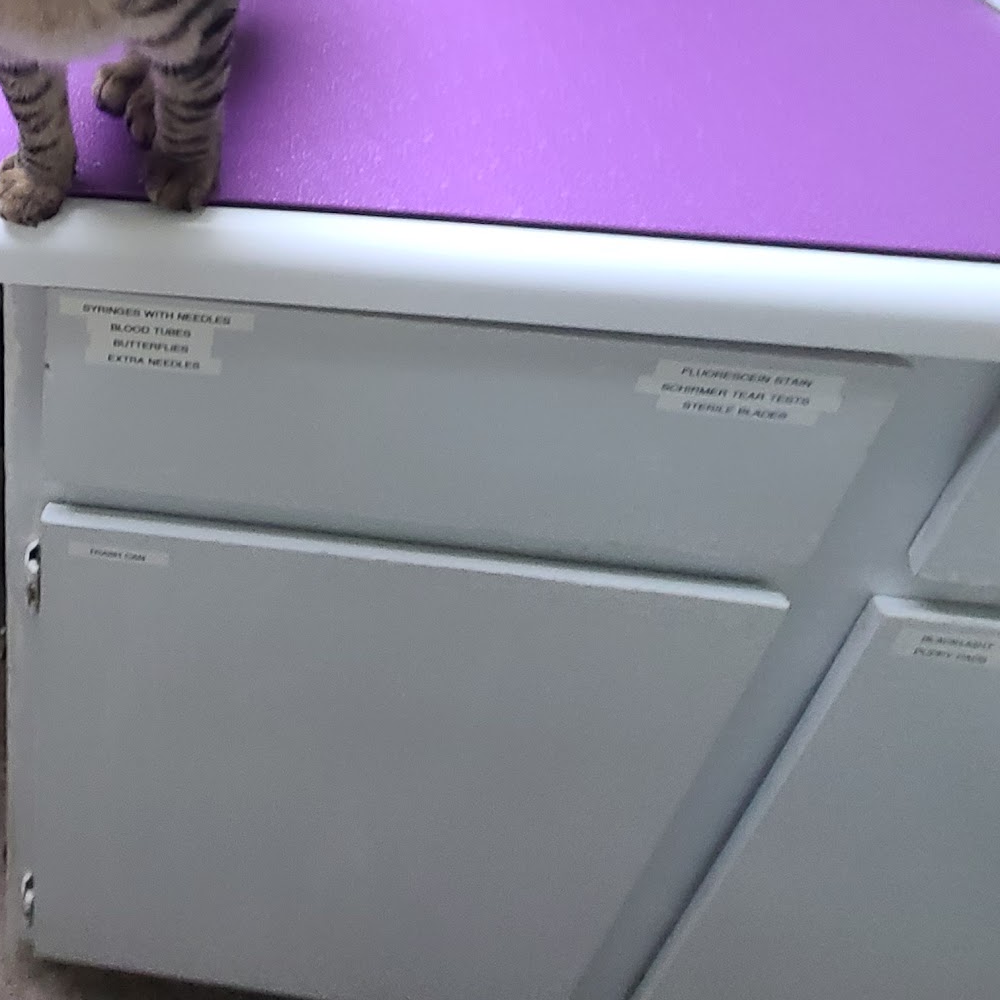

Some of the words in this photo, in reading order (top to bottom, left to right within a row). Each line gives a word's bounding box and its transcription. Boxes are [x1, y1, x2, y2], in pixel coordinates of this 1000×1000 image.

[82, 303, 141, 318] SYRINGES
[143, 309, 174, 321] WITH
[176, 312, 231, 325] NEEDLES
[110, 323, 150, 335] BLOOD
[154, 327, 192, 338] TUBES
[112, 338, 189, 354] BUTTERFLIES
[107, 353, 145, 365] EXTRA
[148, 357, 200, 370] NEEDLES
[681, 366, 772, 384] FLUORESCEIN
[774, 376, 813, 389] STAIN
[660, 383, 729, 398] SCHIRMER
[732, 391, 766, 402] TEAR
[769, 394, 811, 407] TESTS
[682, 400, 733, 414] STERILE
[737, 407, 788, 420] BLADES
